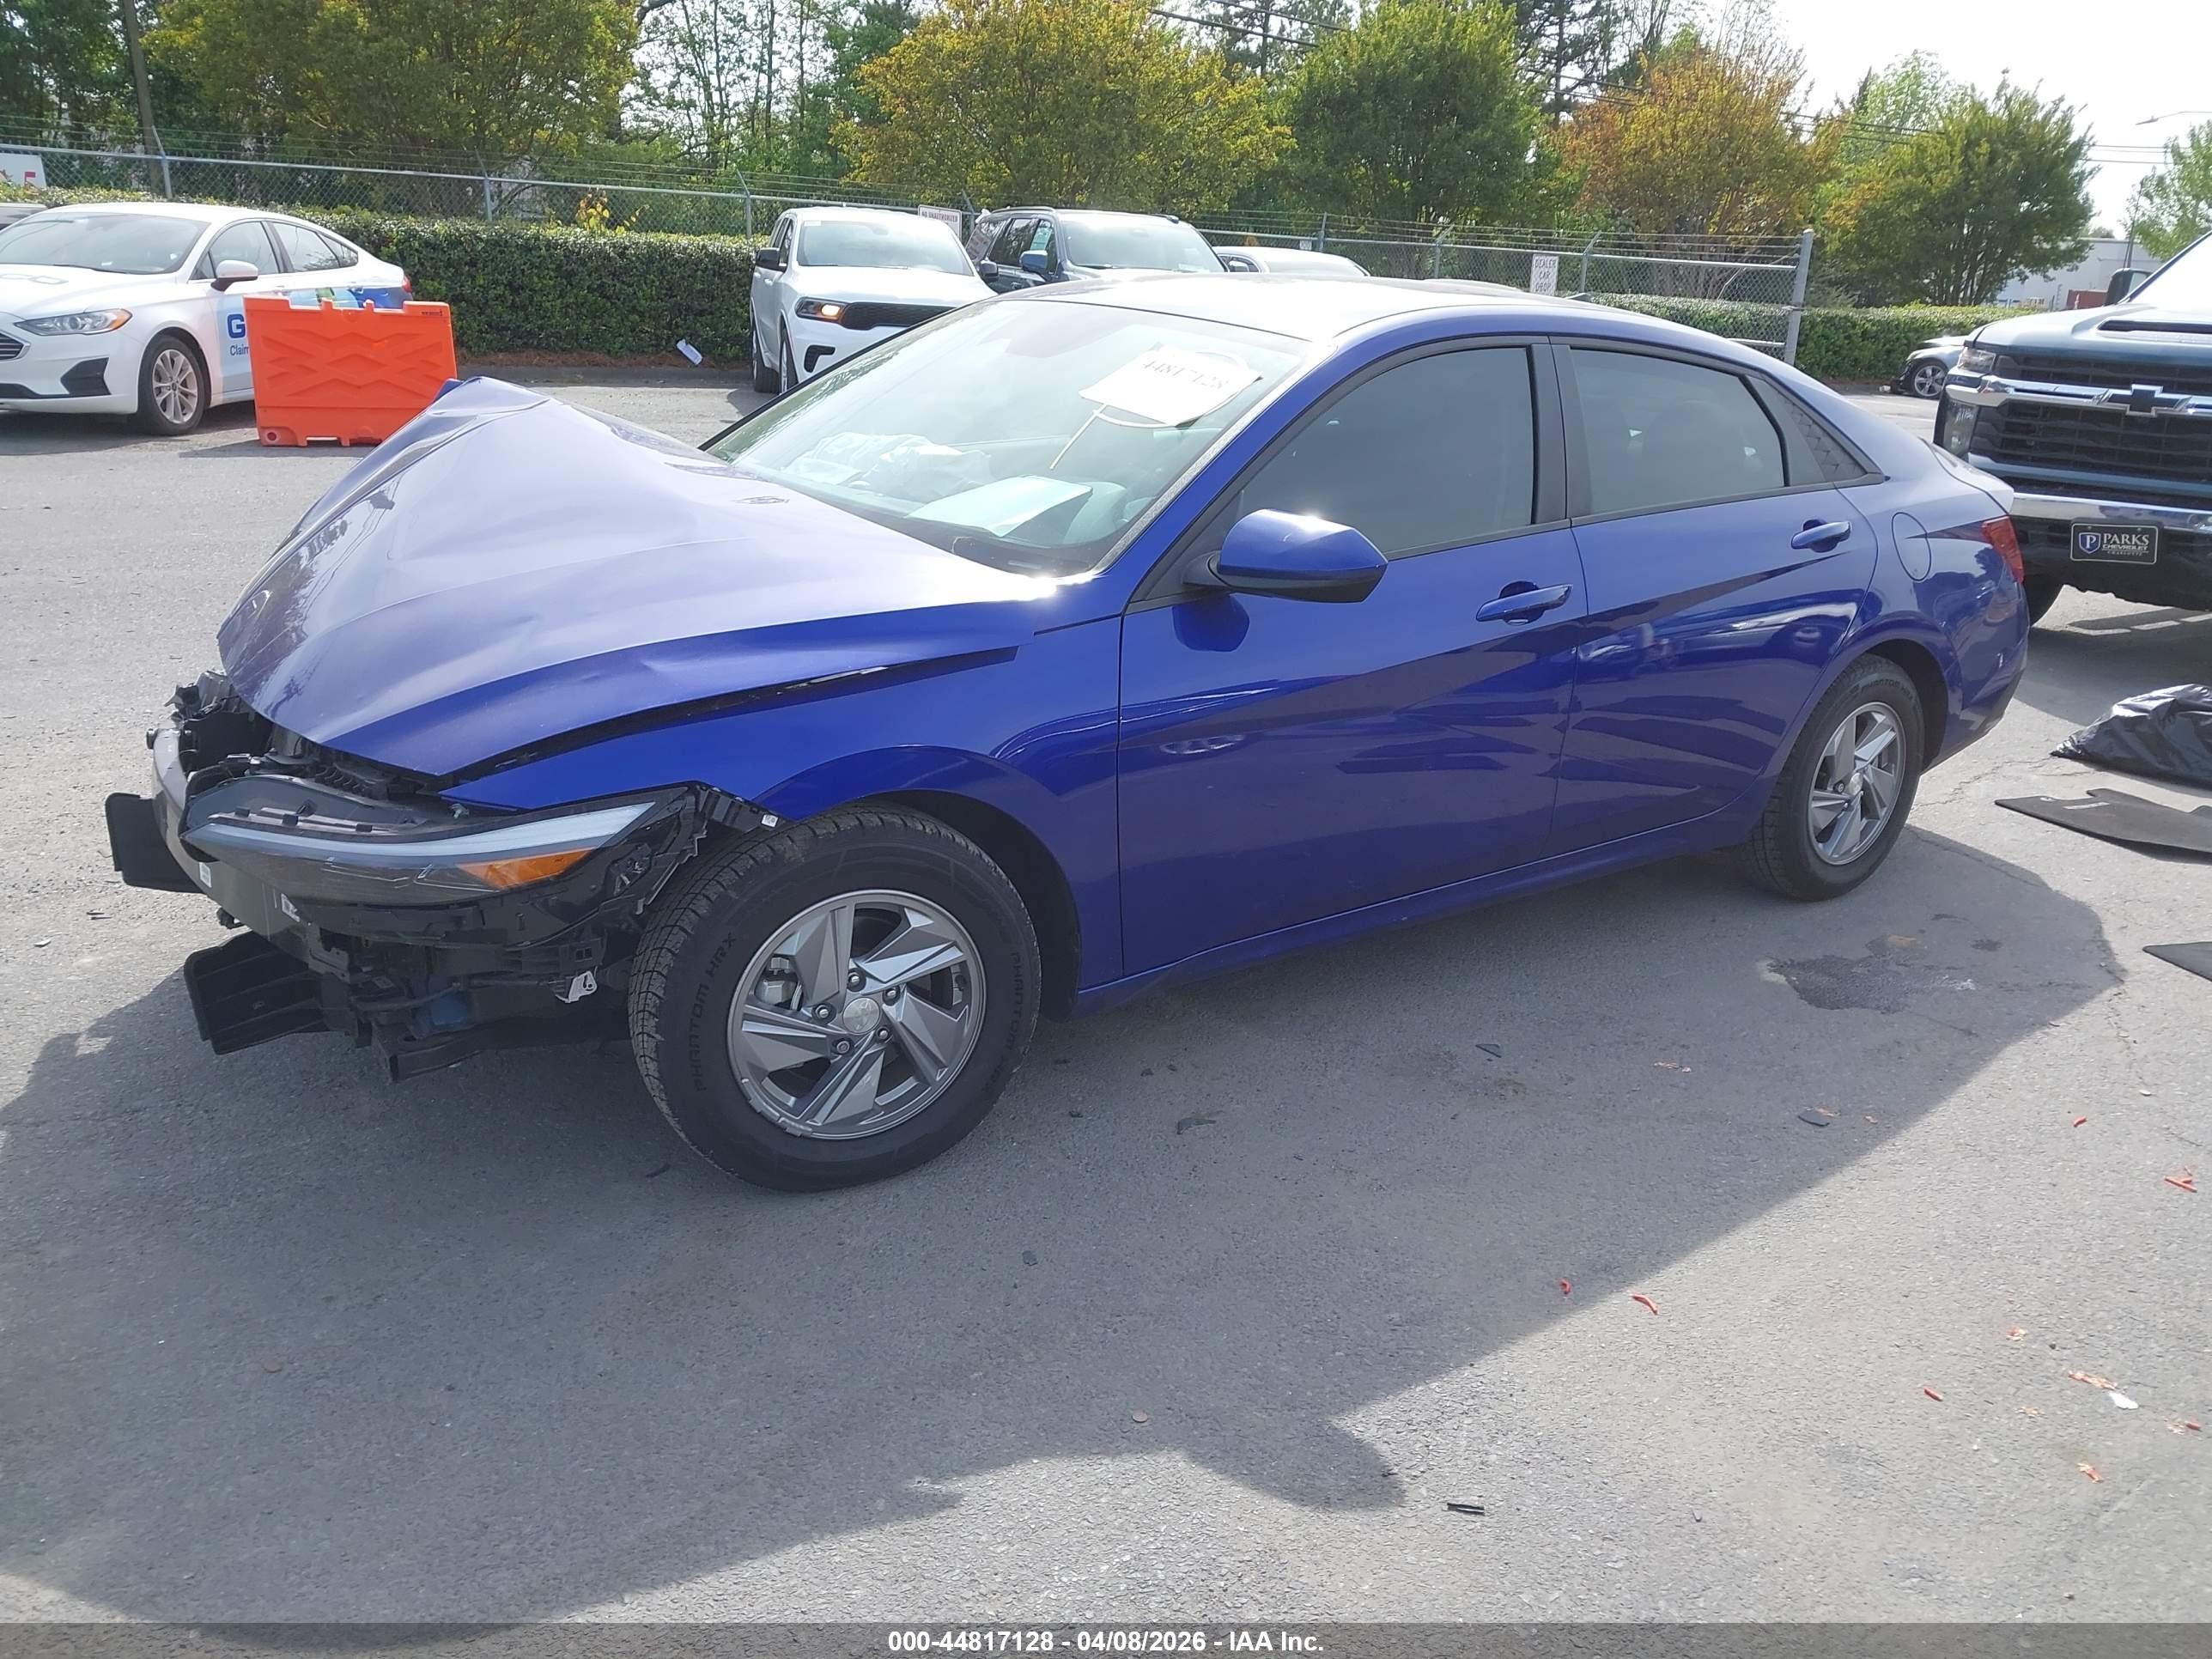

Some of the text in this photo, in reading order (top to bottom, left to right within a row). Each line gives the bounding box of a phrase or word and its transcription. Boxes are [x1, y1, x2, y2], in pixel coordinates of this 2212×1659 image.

[1533, 258, 1557, 269] DEALER
[1539, 270, 1551, 281] CAR
[1535, 282, 1551, 292] DROP
[2102, 532, 2149, 546] PARKS
[688, 932, 737, 1092] PHANTOM HRX
